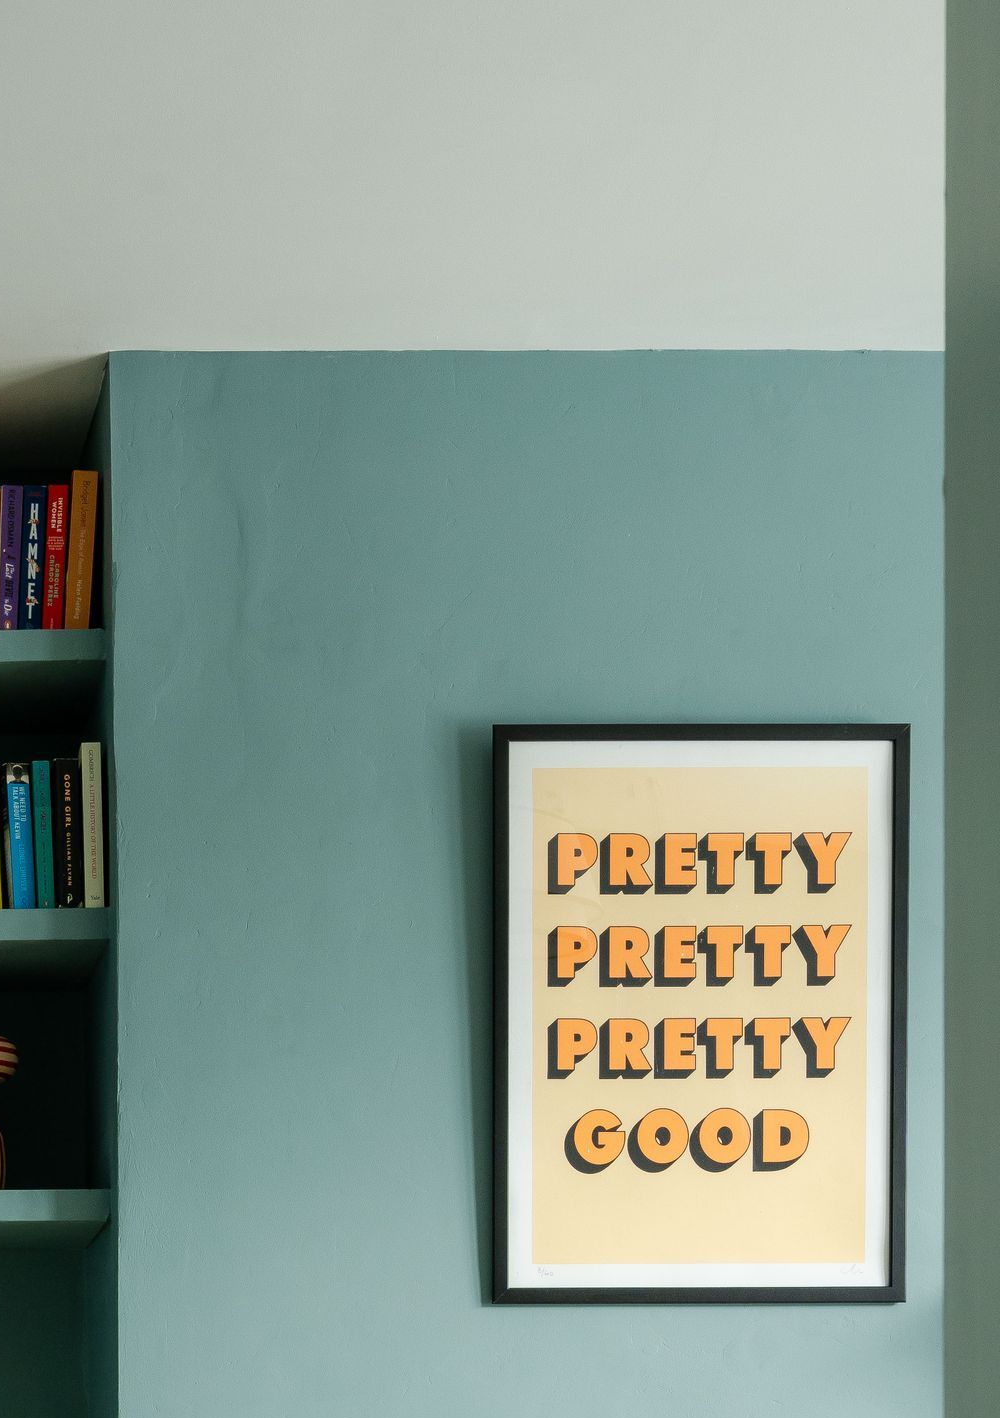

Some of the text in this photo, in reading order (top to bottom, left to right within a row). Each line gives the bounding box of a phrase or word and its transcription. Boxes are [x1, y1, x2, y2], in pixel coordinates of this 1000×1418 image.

[8, 489, 16, 519] RICHARD
[81, 480, 91, 504] Bridget
[27, 503, 40, 619] HAMNET
[4, 563, 14, 616] Last Die
[73, 579, 83, 620] Helen Fielding
[19, 786, 25, 795] WE
[91, 836, 97, 844] OF
[547, 831, 853, 895] PRETTY
[547, 924, 853, 988] PRETTY
[547, 1016, 852, 1080] PRETTY
[564, 1107, 810, 1174] GOOD
